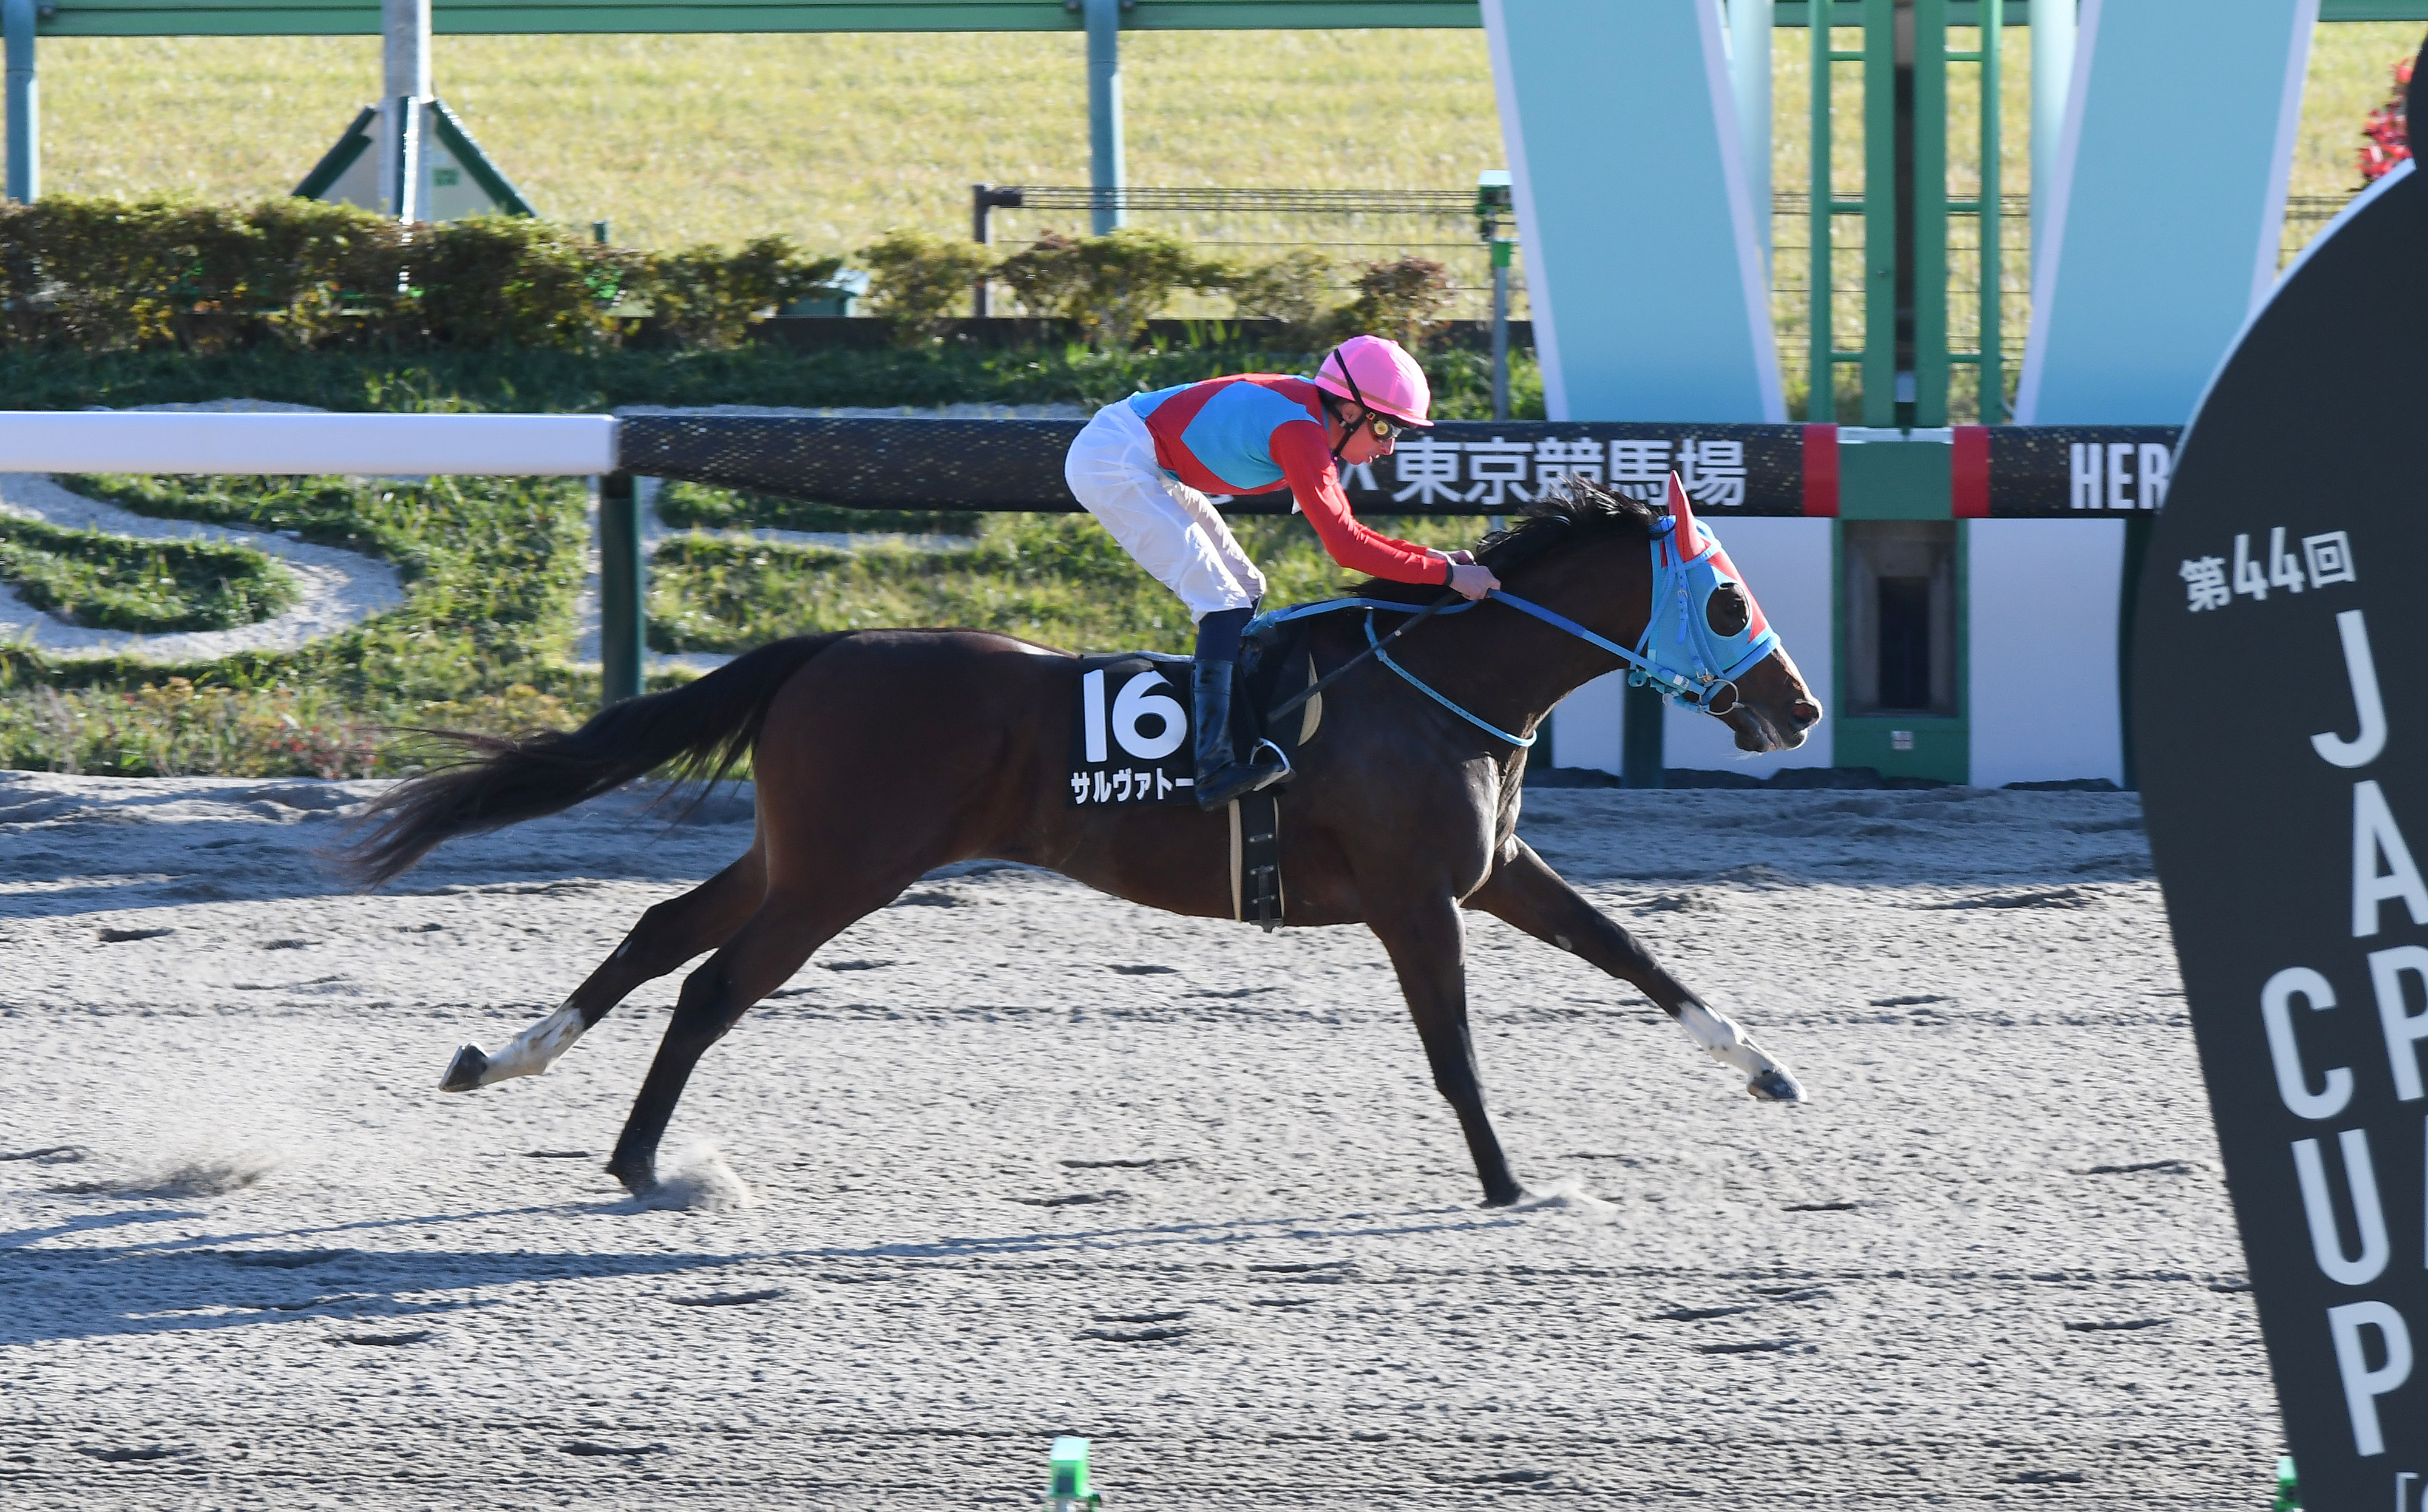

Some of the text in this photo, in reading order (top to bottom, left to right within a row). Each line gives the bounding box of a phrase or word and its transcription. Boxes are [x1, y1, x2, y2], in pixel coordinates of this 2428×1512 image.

[1392, 435, 1748, 506] 東京競馬場
[2178, 526, 2356, 612] 第44回
[1083, 668, 1187, 763] 16
[1070, 767, 1195, 805] サルヴァトー
[2310, 609, 2428, 1272] JAP
[2260, 966, 2414, 1457] CUP
